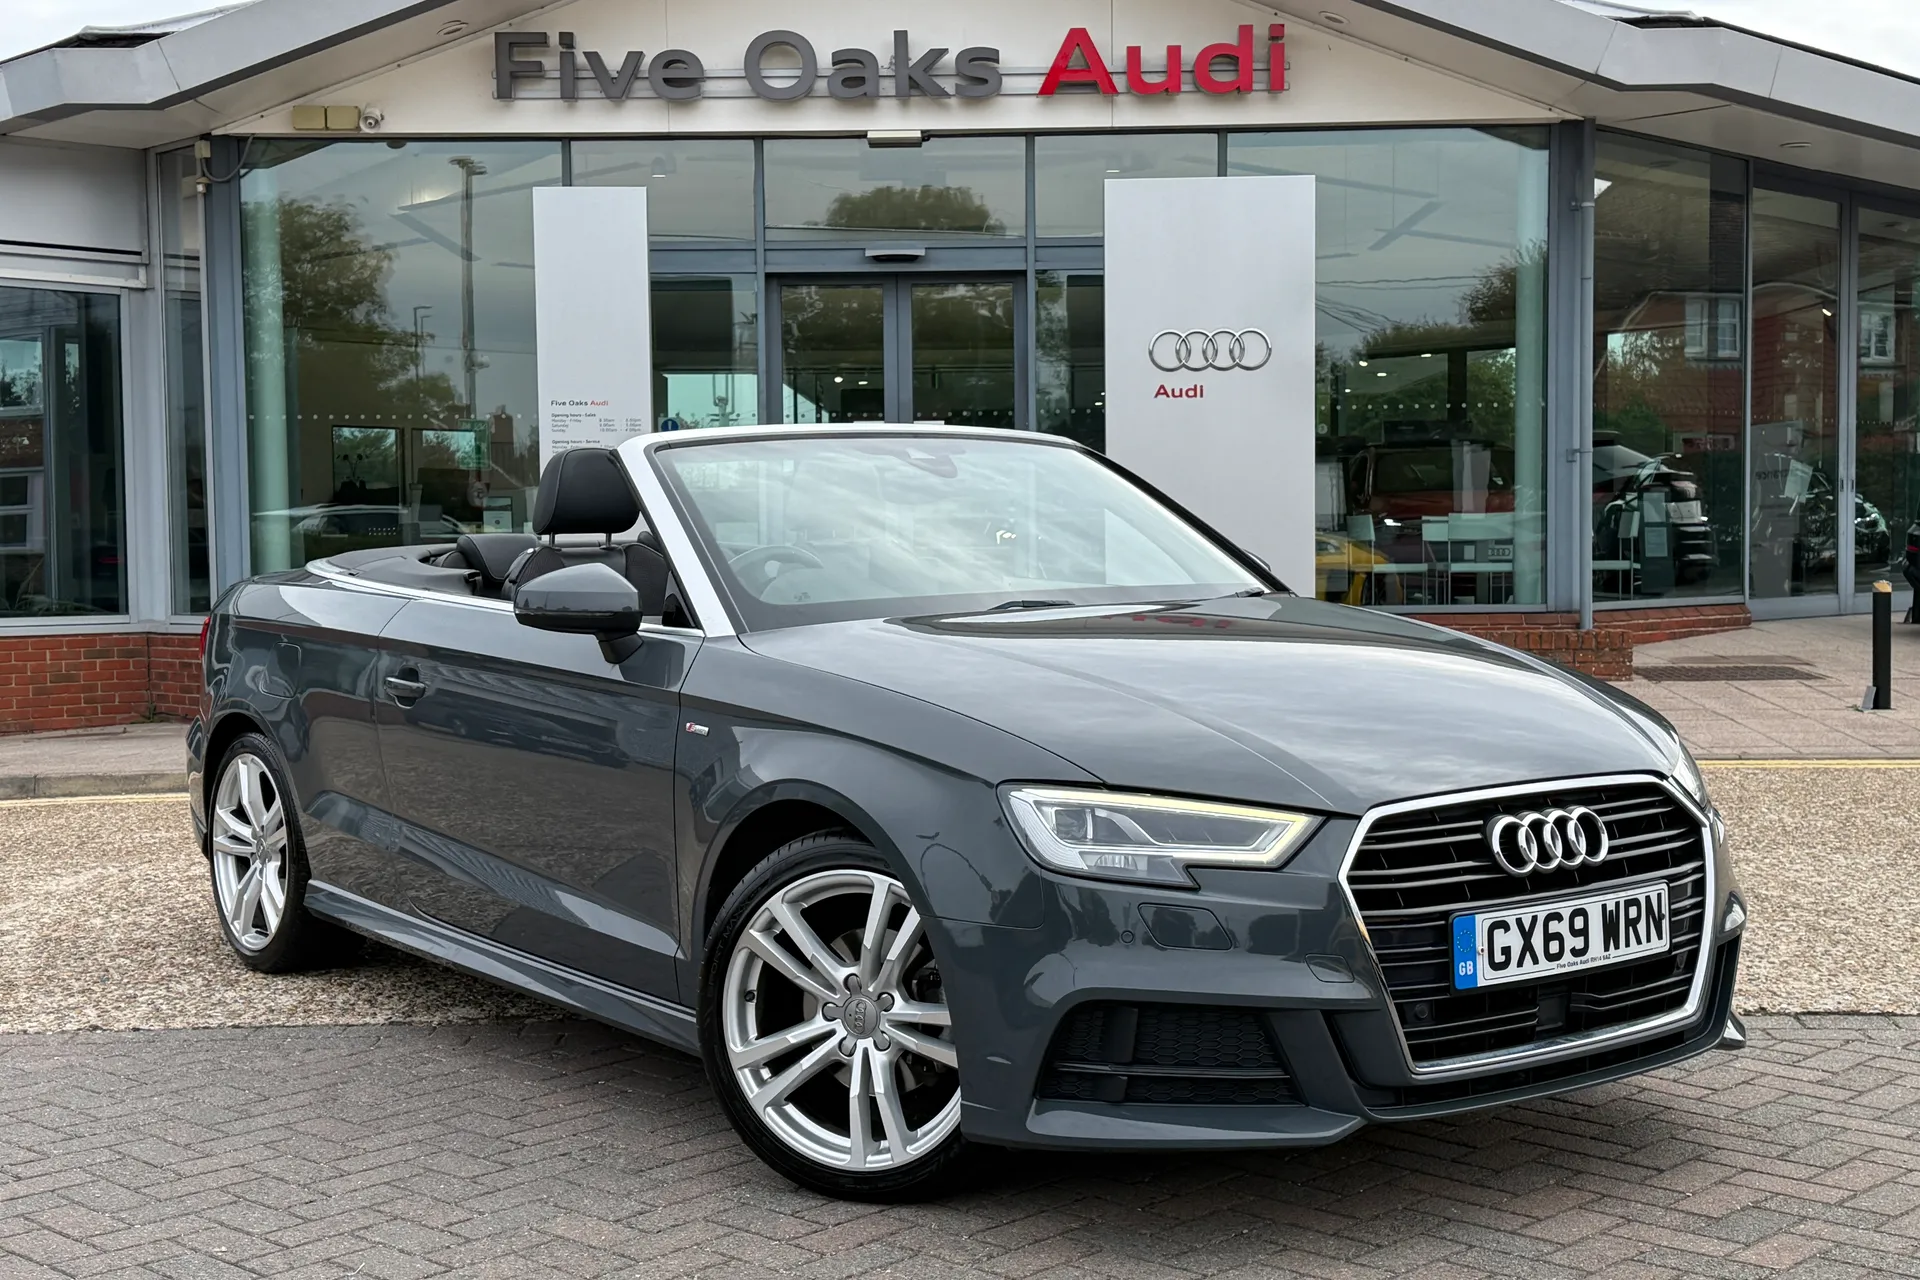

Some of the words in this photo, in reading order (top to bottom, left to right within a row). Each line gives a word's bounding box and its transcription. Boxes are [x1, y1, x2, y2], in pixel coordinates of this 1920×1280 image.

[493, 31, 704, 100] Five
[744, 30, 1002, 100] Oaks
[1037, 23, 1286, 97] Audi
[1154, 383, 1204, 398] Audi
[1487, 907, 1590, 972] GX69
[1601, 892, 1664, 953] WRN
[1458, 960, 1474, 977] GB
